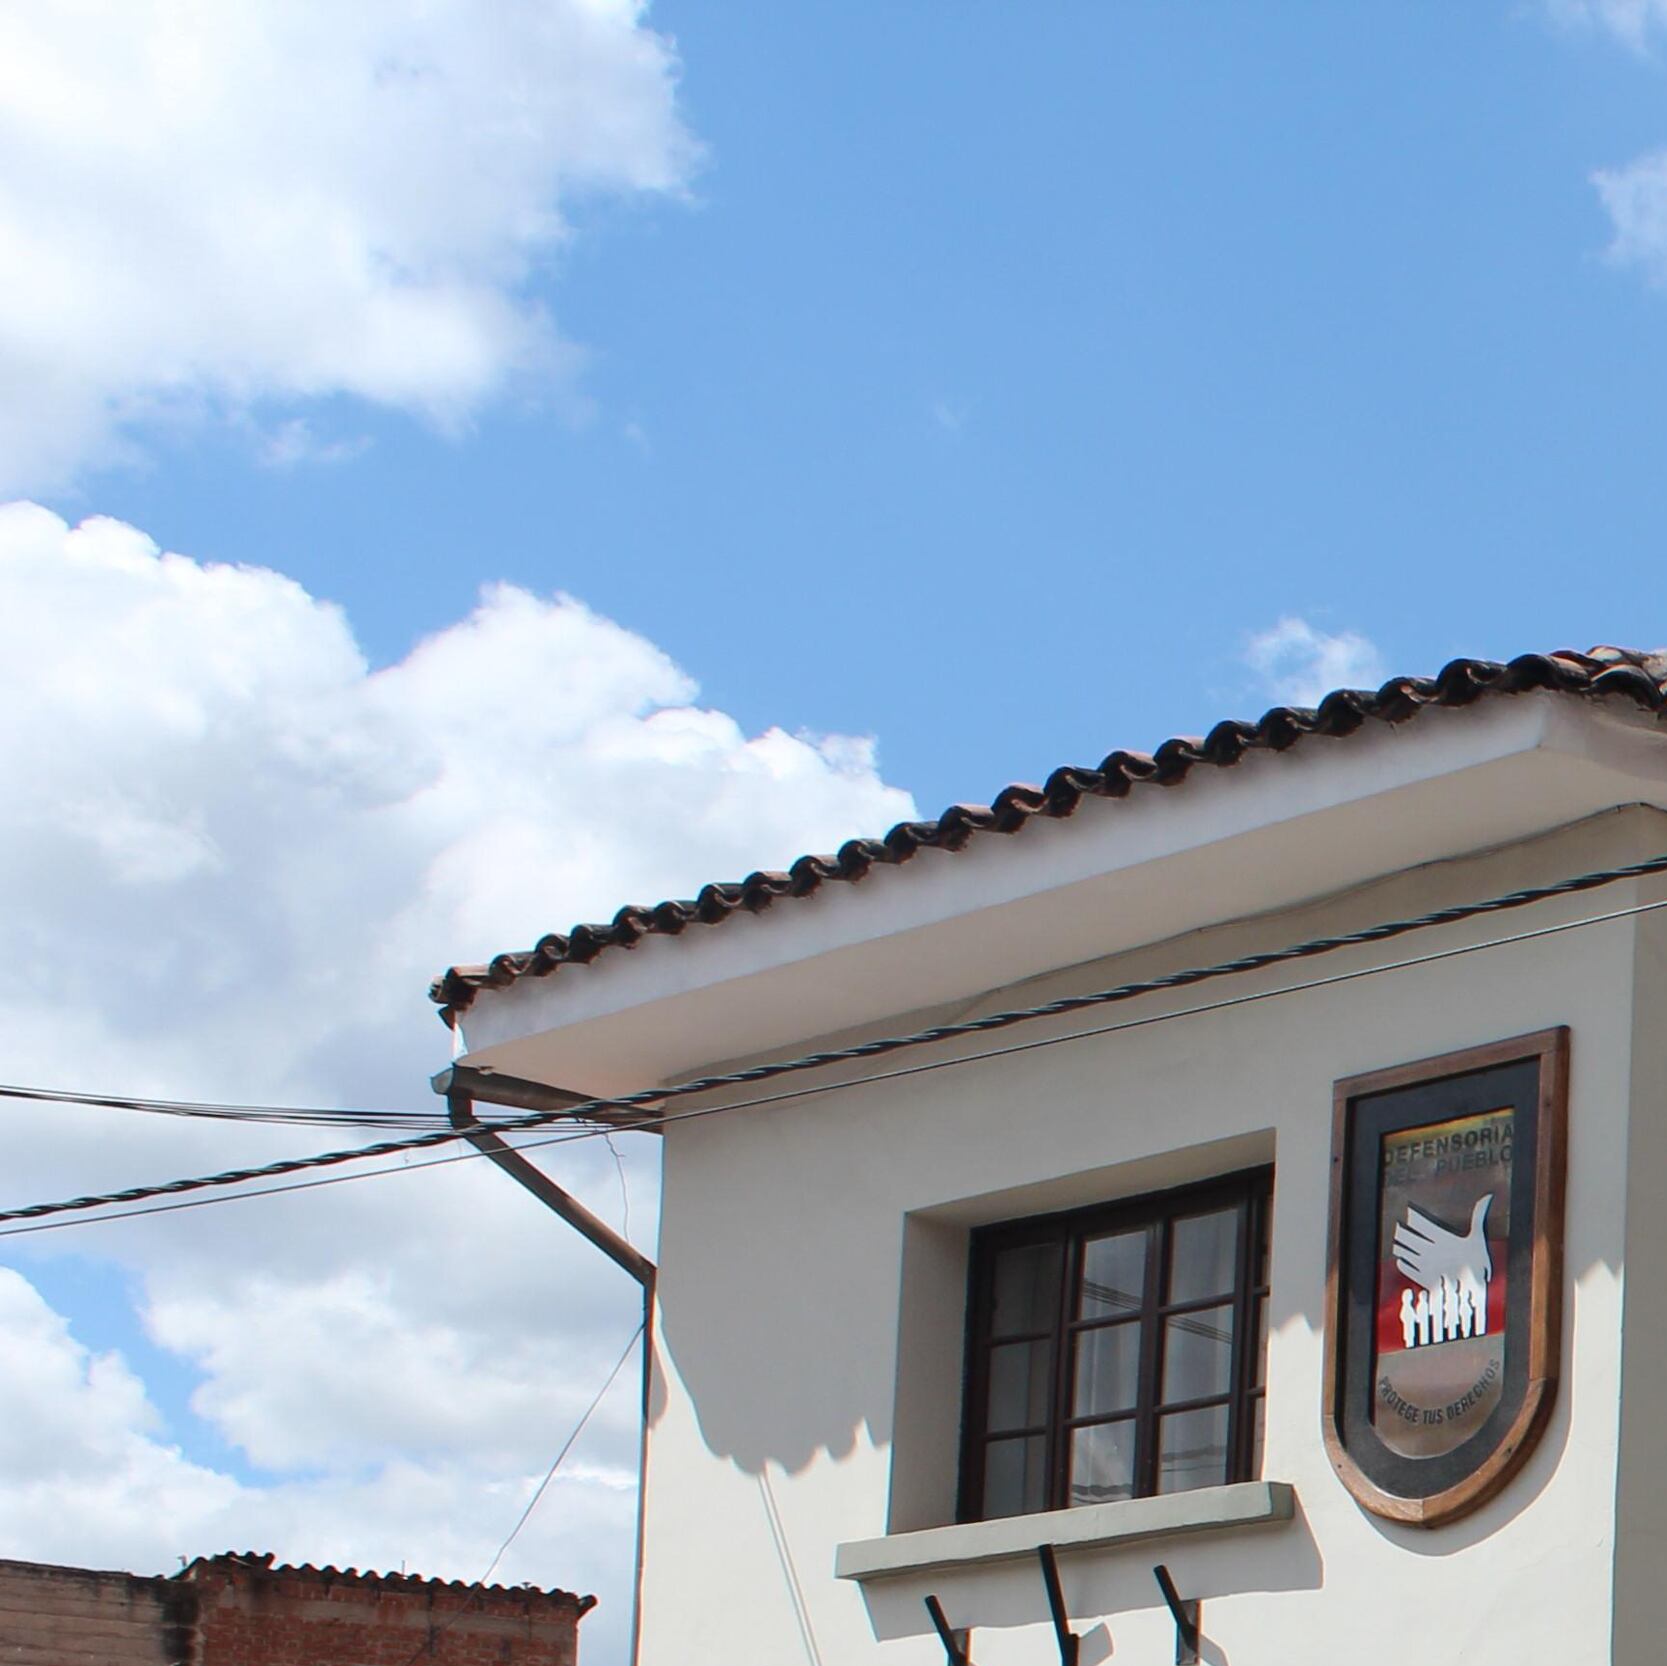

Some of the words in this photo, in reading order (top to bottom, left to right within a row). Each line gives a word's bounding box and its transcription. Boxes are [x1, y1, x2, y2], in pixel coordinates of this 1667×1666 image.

[1384, 1123, 1513, 1166] DEFENSORIA
[1379, 1375, 1420, 1423] PROTEGE
[1423, 1407, 1444, 1425] TUS
[1446, 1359, 1500, 1420] DERECHOS
